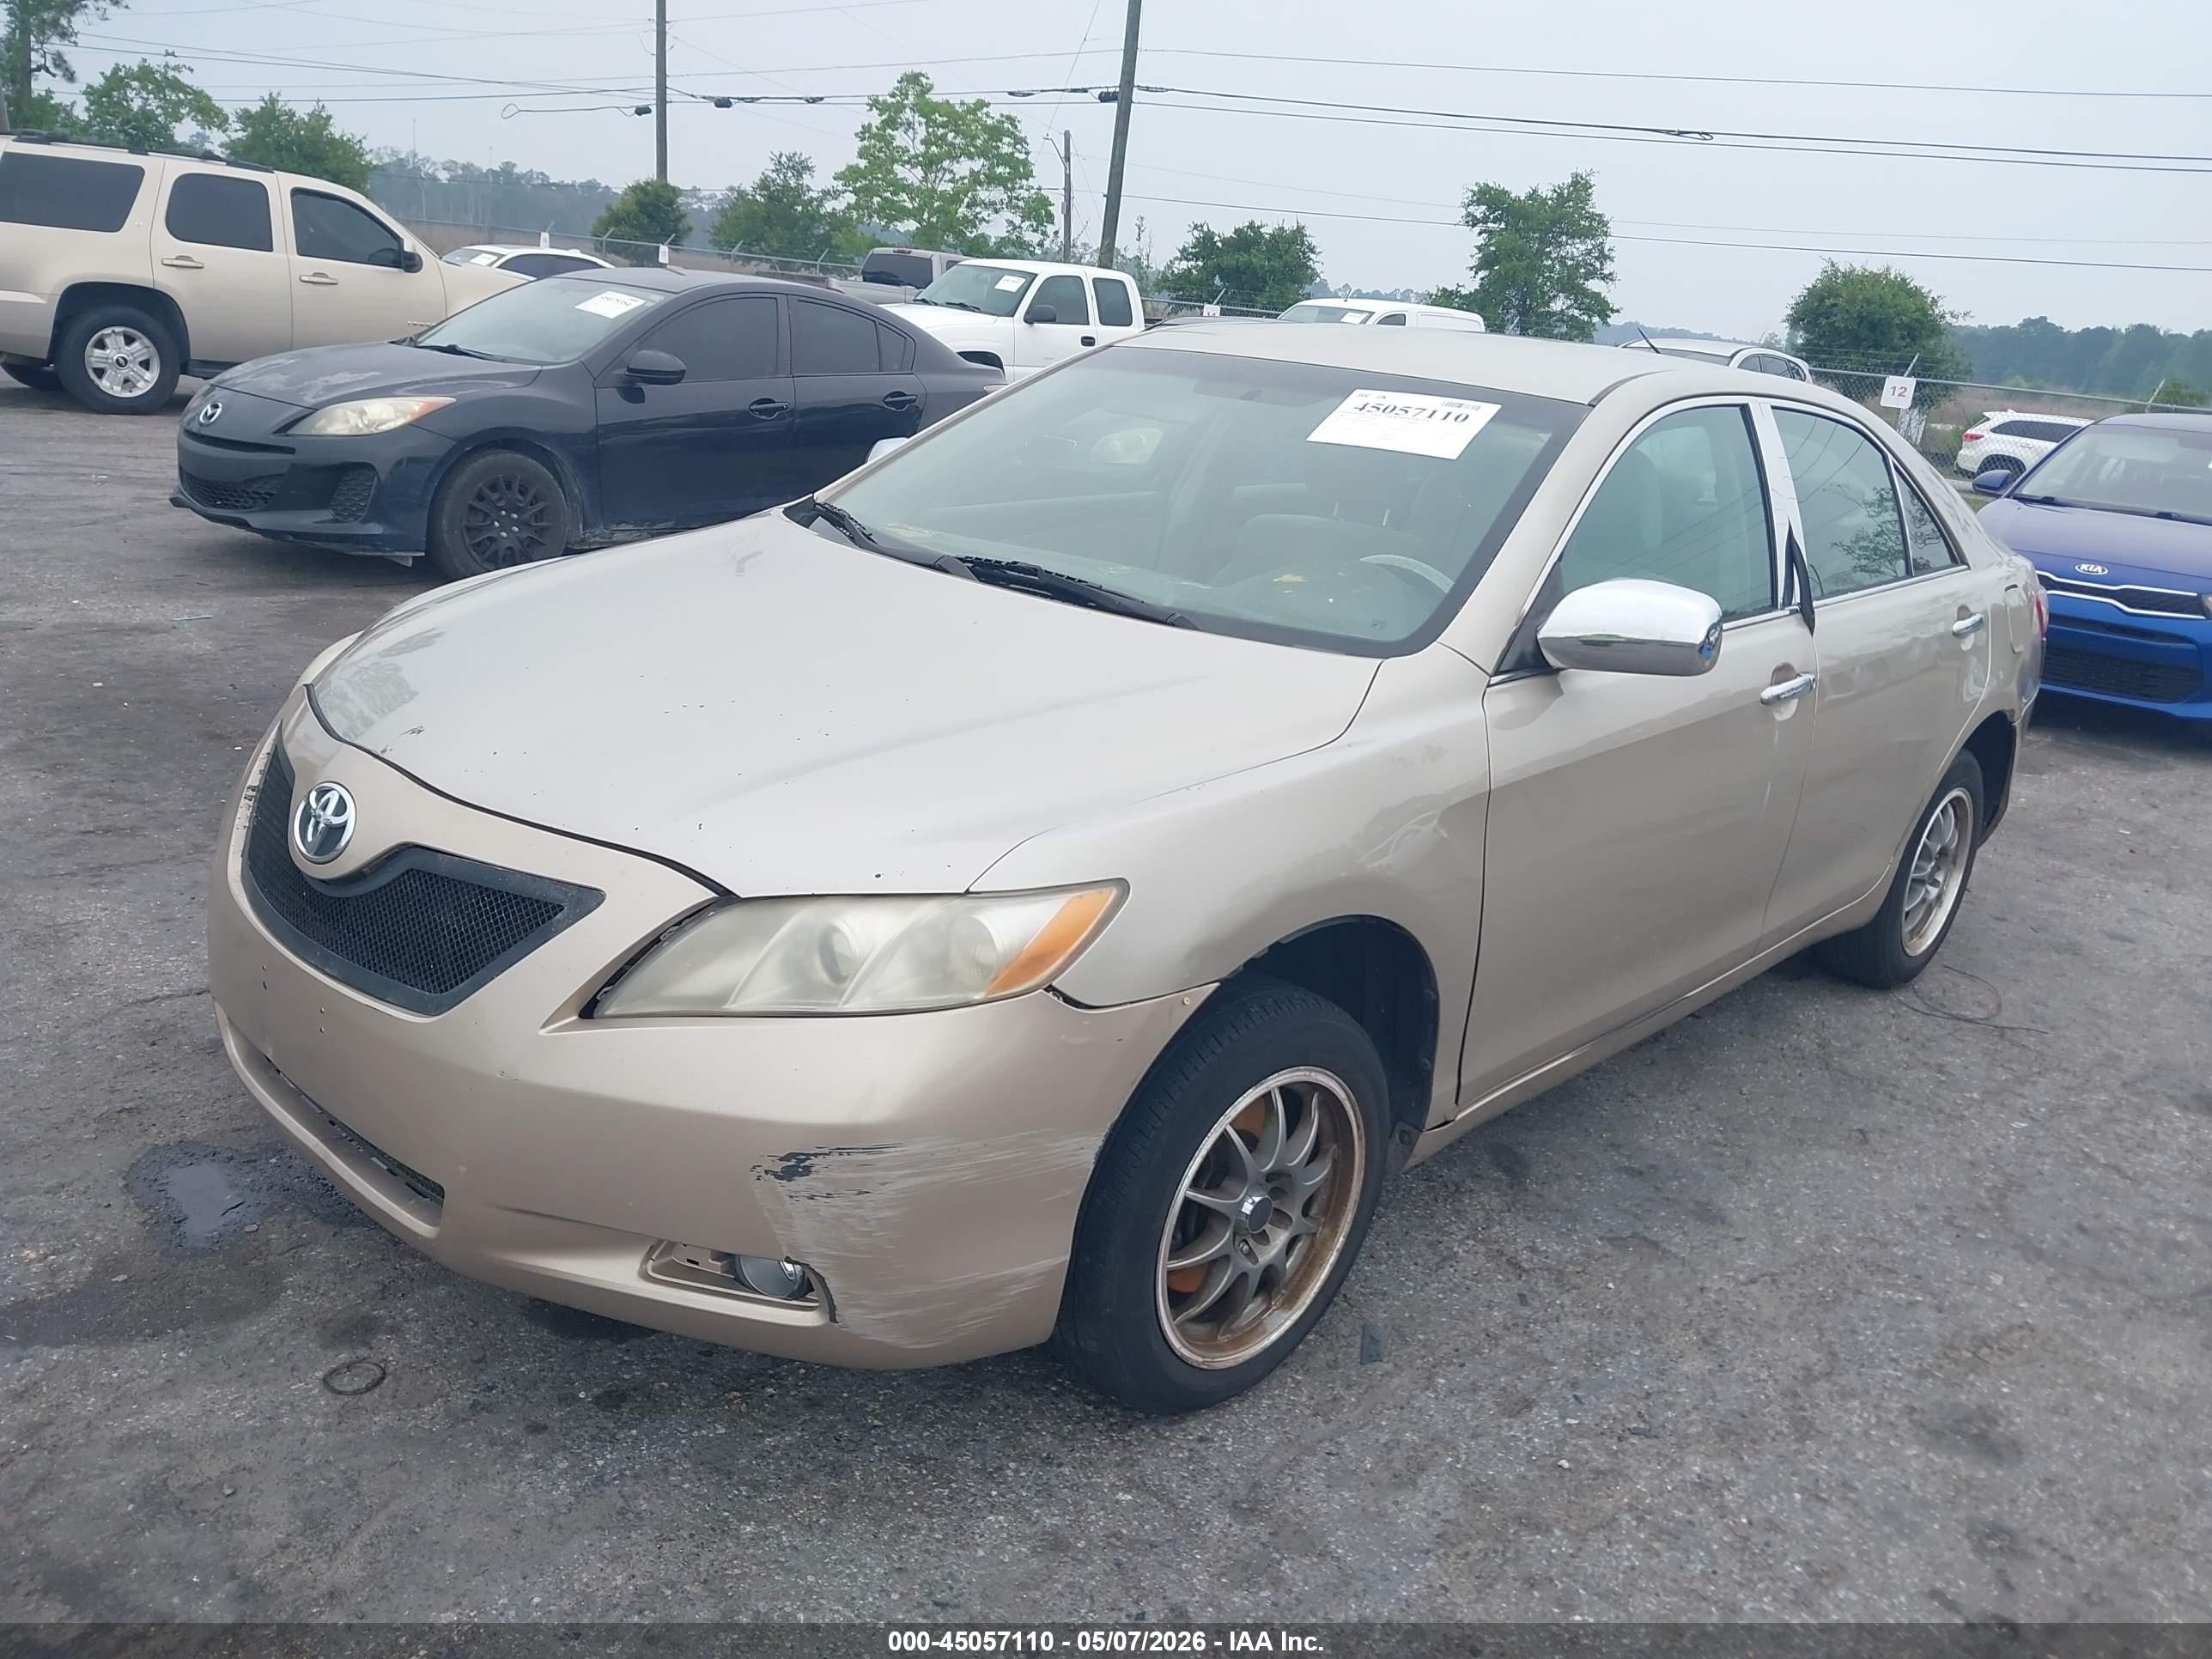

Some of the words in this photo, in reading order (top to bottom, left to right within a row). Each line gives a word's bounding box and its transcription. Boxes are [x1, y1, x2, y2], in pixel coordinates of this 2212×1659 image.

[1890, 385, 1908, 398] 12
[1353, 402, 1470, 423] 45057110
[2079, 563, 2103, 574] KIA
